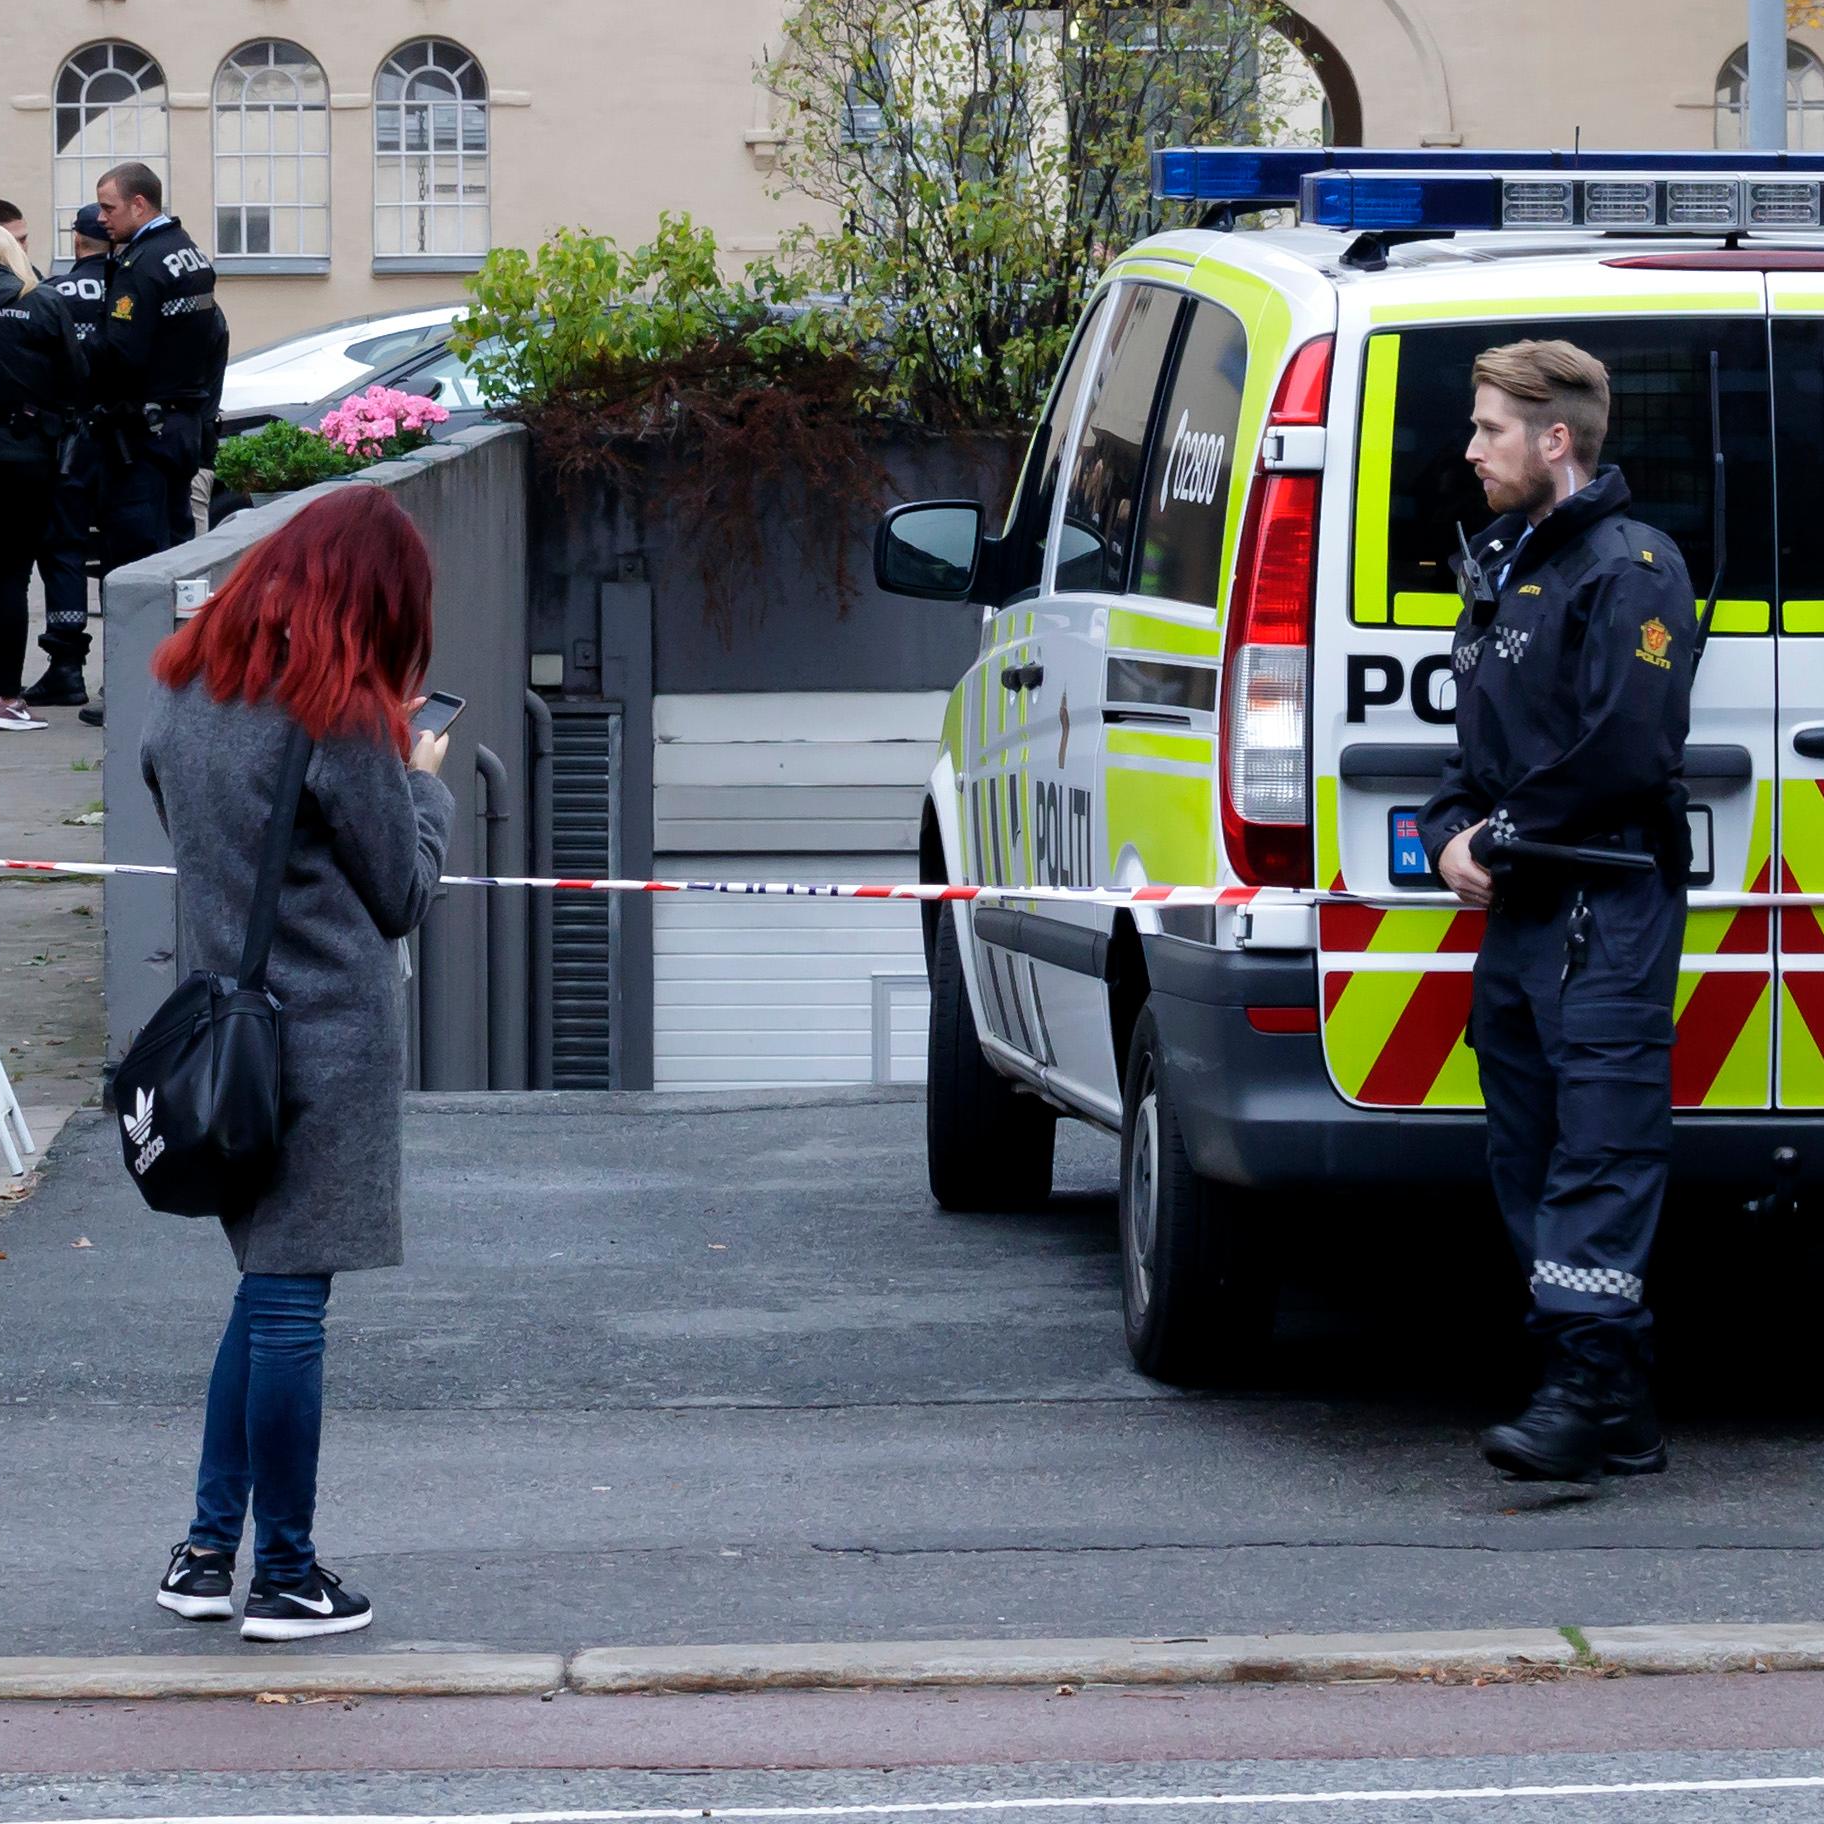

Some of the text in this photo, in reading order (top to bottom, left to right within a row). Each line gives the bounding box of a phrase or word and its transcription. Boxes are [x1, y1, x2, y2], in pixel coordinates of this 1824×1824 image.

[1172, 430, 1226, 505] 02800
[1036, 780, 1091, 887] POLITI
[1402, 852, 1416, 866] N
[134, 1135, 165, 1175] adidas
